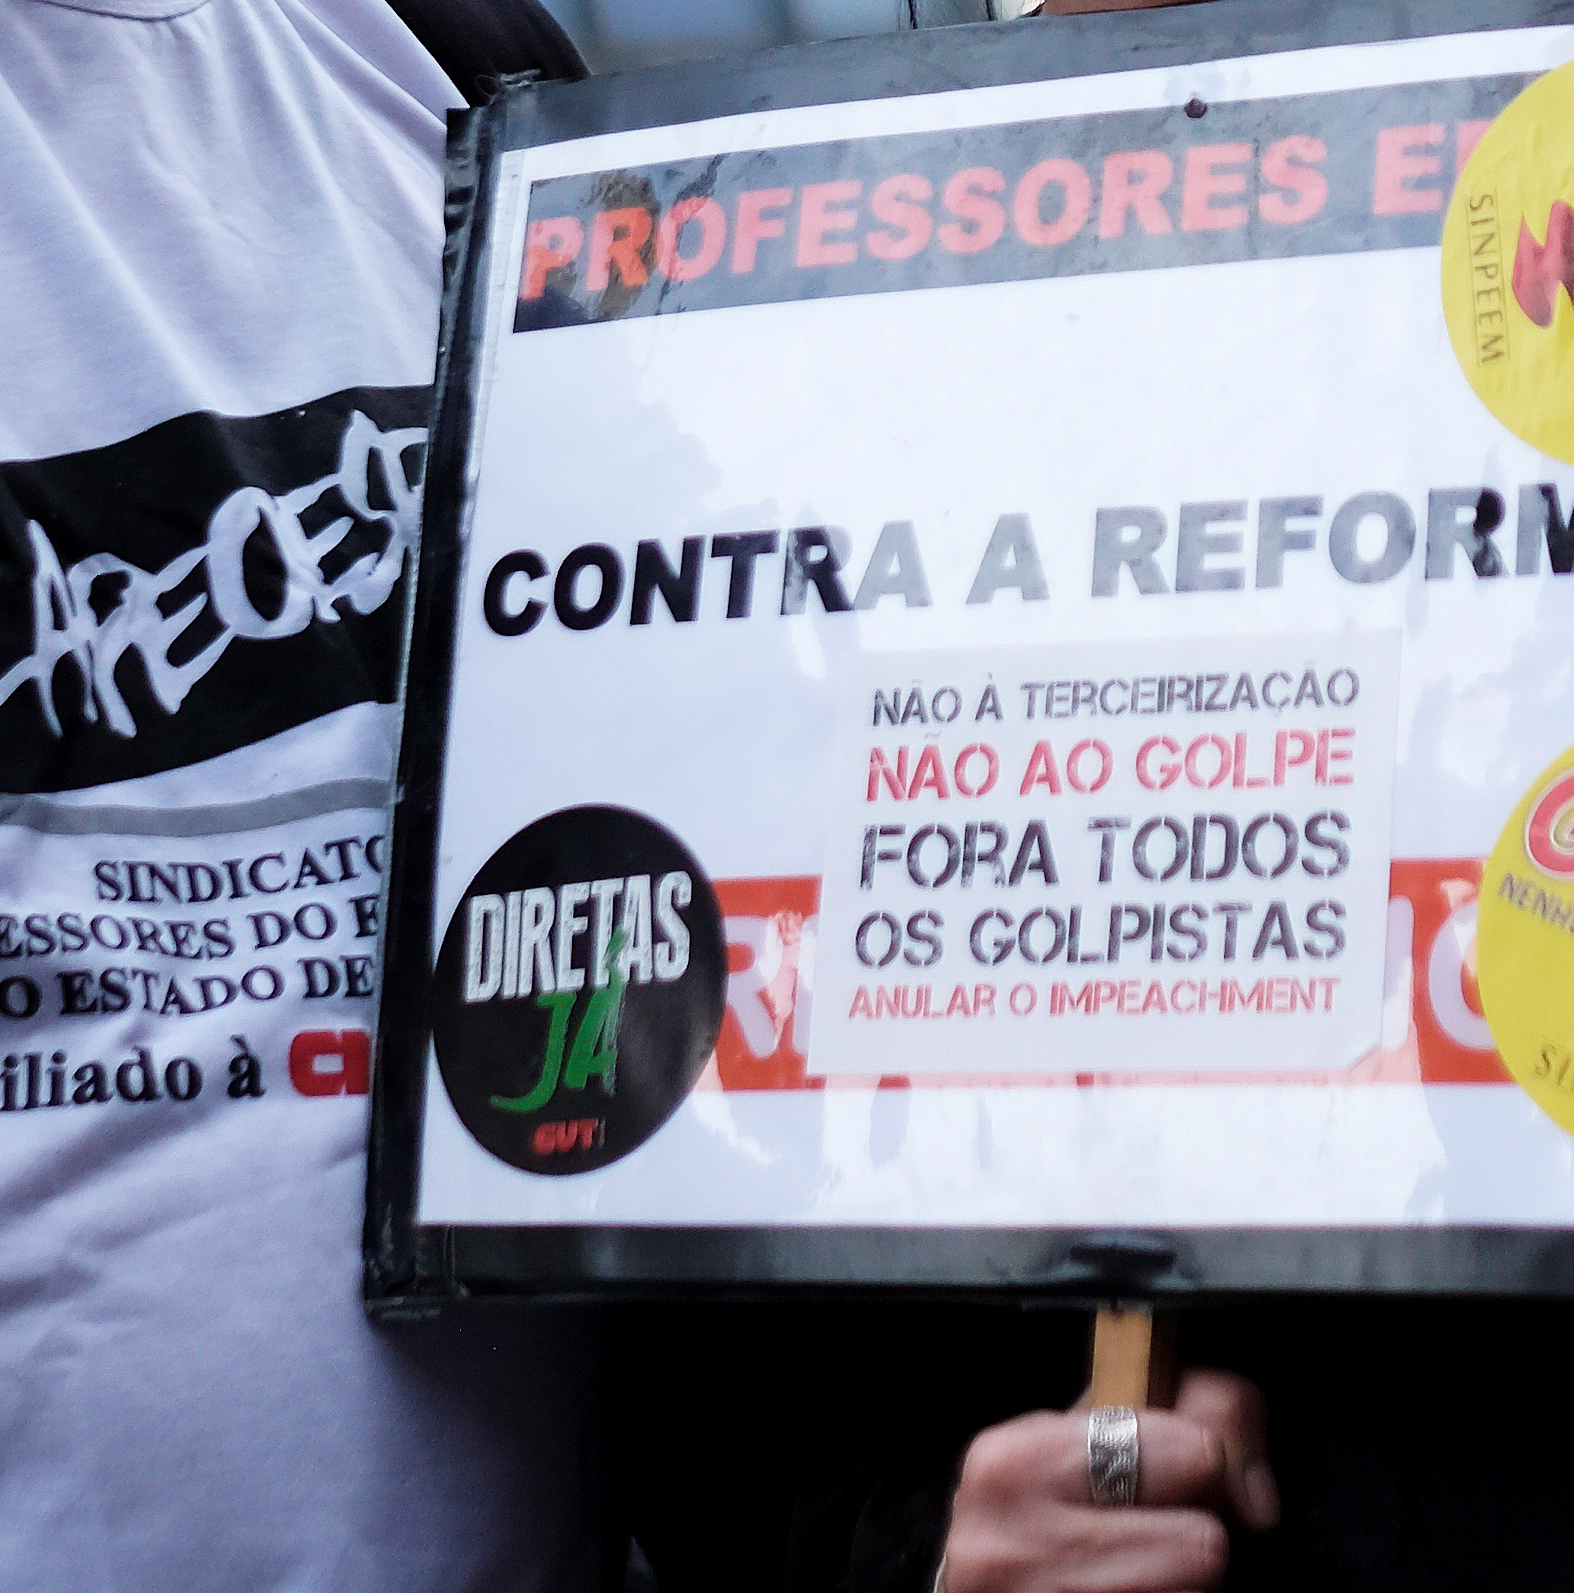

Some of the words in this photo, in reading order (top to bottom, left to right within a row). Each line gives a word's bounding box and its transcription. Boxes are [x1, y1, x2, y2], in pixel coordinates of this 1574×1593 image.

[518, 133, 1328, 301] PROFESSORES
[1469, 193, 1506, 364] SINPEEM
[483, 519, 933, 637] CONTRA
[965, 513, 1050, 605] A
[1019, 738, 1114, 796] AO
[1135, 728, 1356, 792] GOLPE
[859, 818, 1060, 889] FORA
[1086, 810, 1352, 884] TODOS
[250, 901, 338, 950] DO
[463, 870, 693, 1003] DIRETAS
[854, 909, 944, 968] OS
[969, 900, 1348, 968] GOLPISTAS
[58, 964, 285, 1019] ESTADO
[296, 955, 376, 999] DE
[848, 981, 997, 1021] ANULAR
[1009, 981, 1038, 1017] O
[1048, 975, 1342, 1017] IMPEACHMENT
[226, 1035, 266, 1100] à
